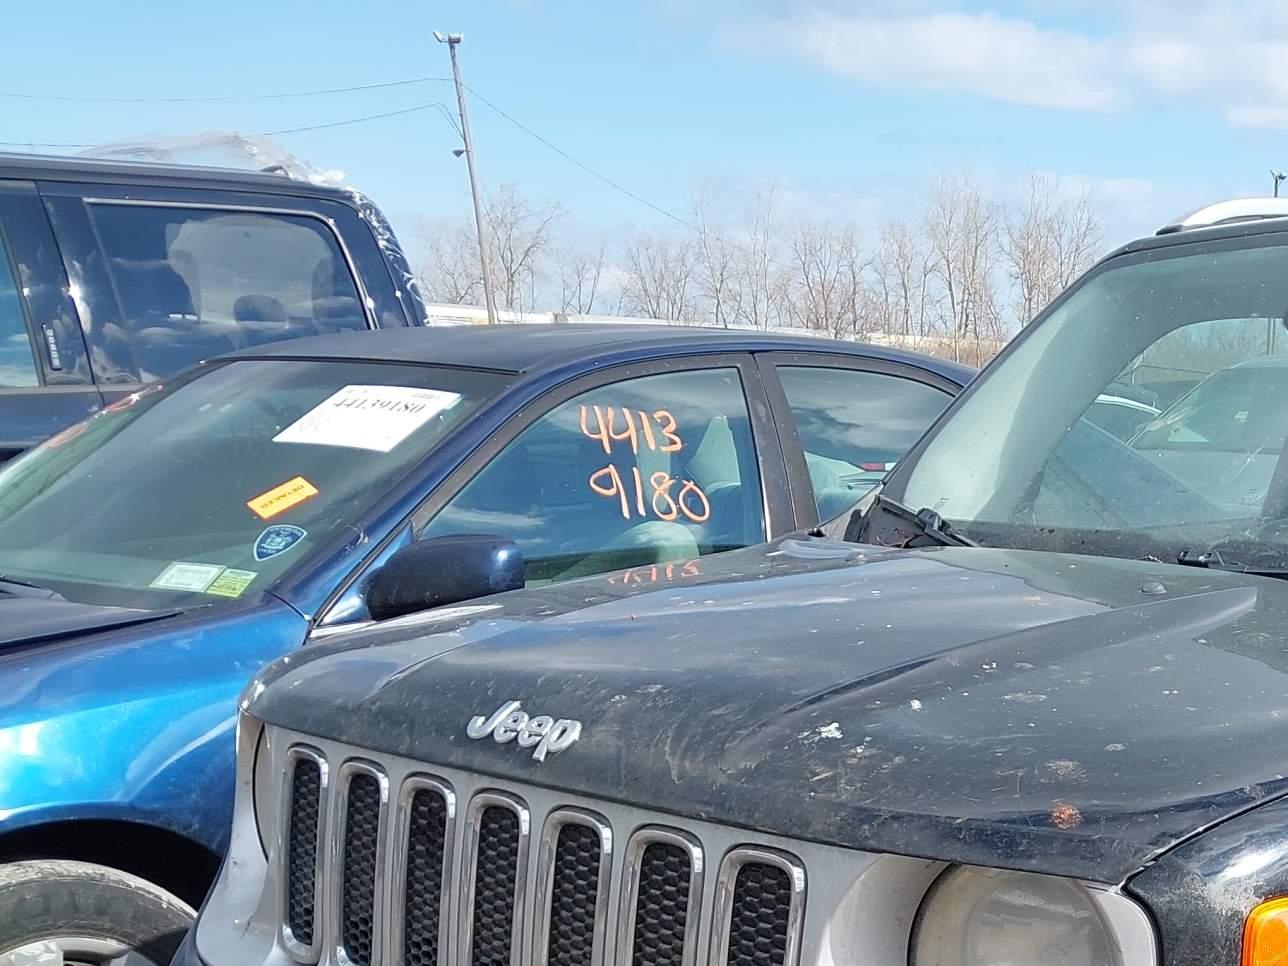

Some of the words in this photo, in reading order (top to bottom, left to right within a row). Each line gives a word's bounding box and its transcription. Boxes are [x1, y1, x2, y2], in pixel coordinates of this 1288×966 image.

[580, 405, 682, 454] 4413
[589, 464, 710, 522] 9180
[466, 700, 582, 762] Jeep
